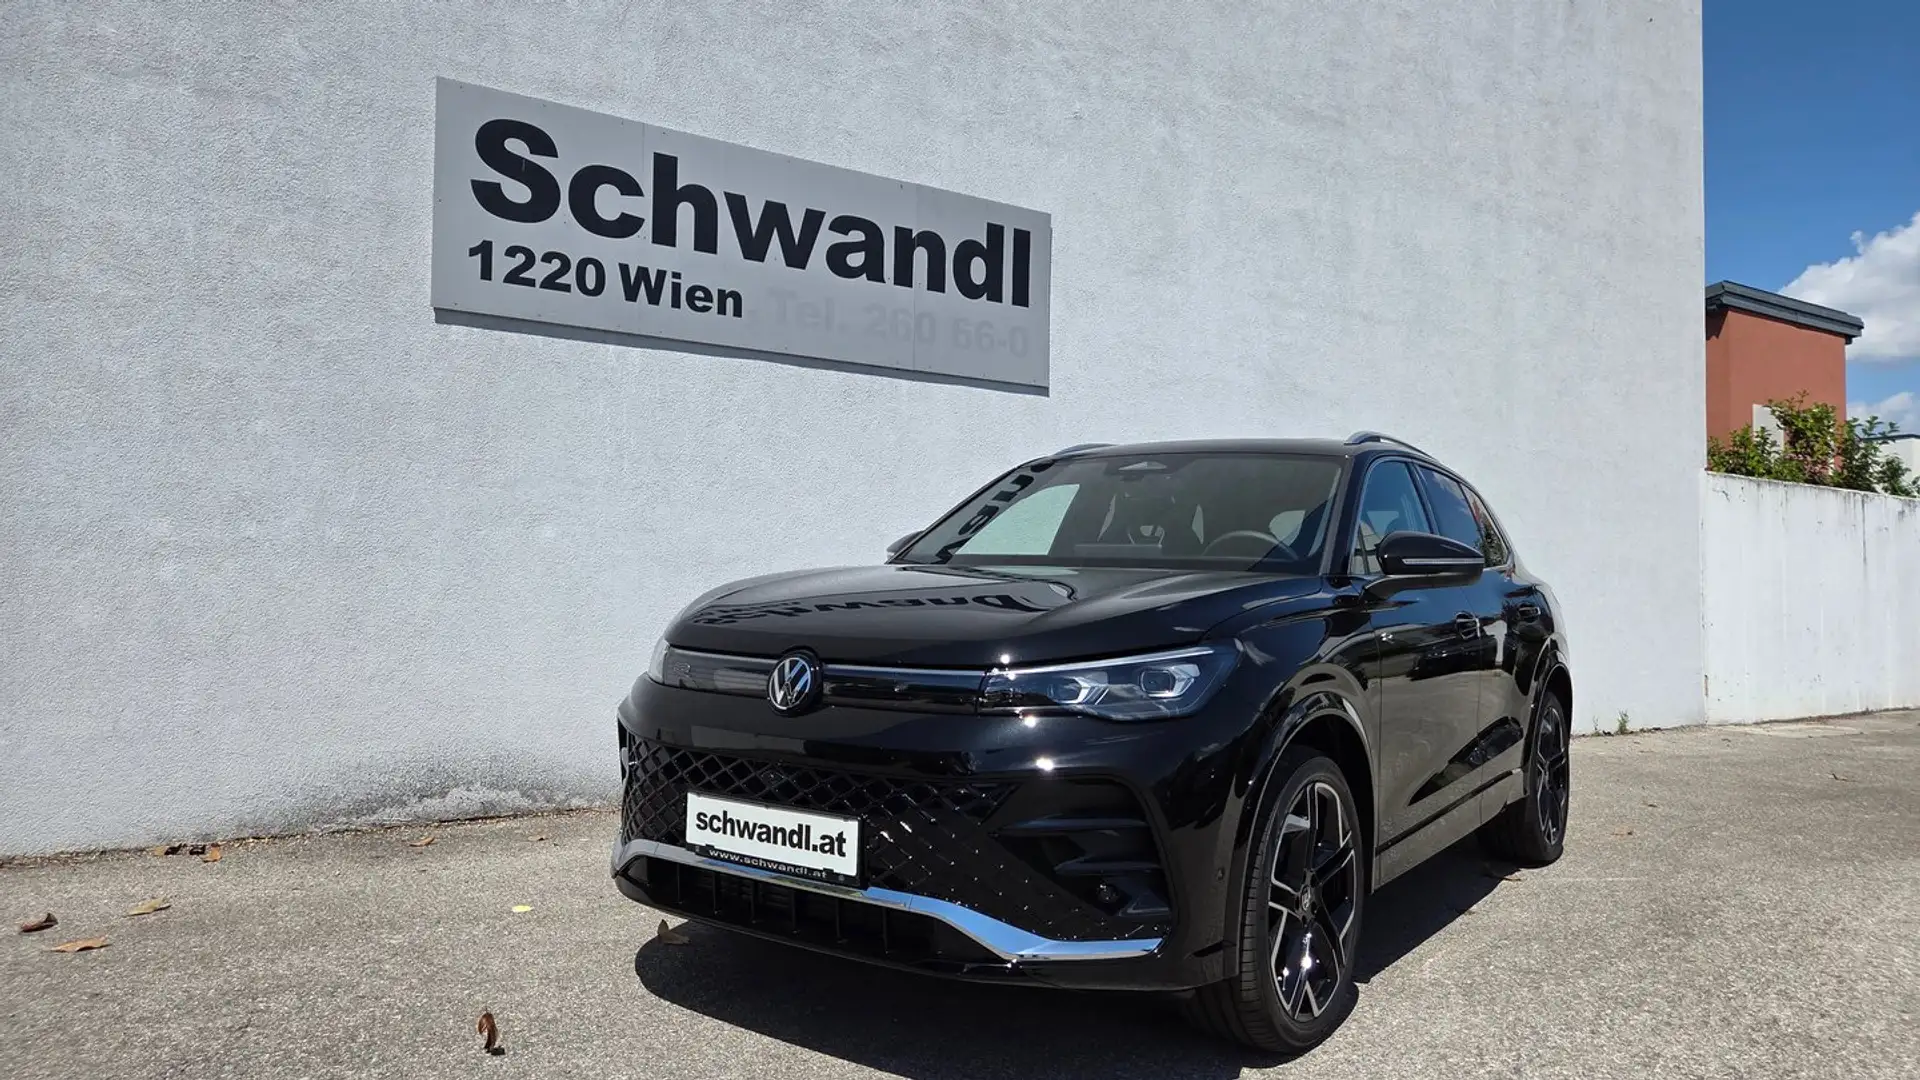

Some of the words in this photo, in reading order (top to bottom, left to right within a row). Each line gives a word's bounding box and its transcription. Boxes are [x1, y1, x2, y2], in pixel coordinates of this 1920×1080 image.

[470, 118, 1031, 308] Schwandl
[468, 239, 606, 297] 1220
[618, 262, 743, 319] Wien
[766, 286, 849, 333] Tel.
[861, 301, 936, 345] 260
[696, 811, 847, 858] schwandl.at
[708, 849, 828, 879] www.schwandl.at
